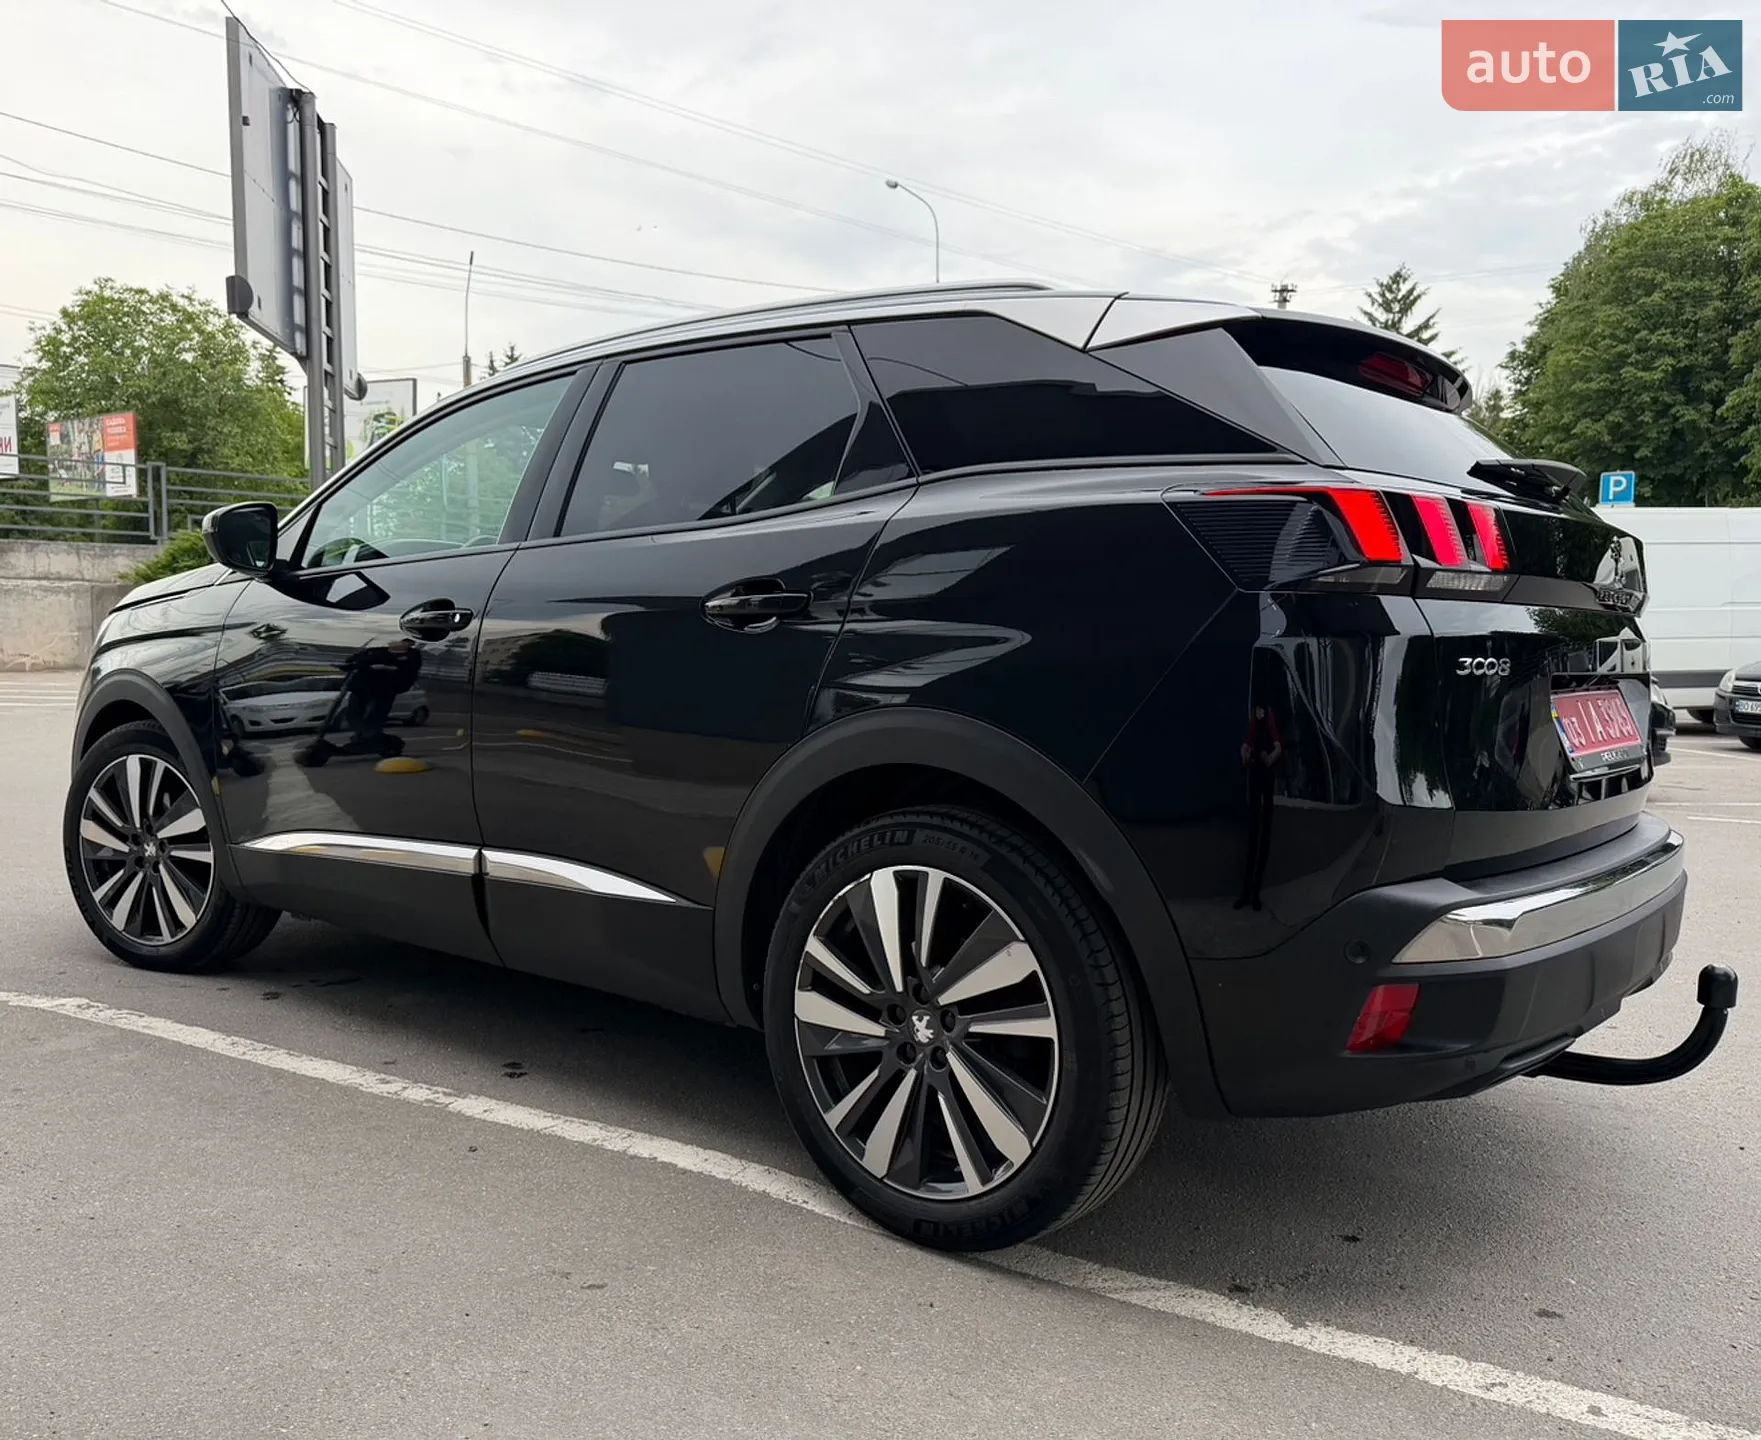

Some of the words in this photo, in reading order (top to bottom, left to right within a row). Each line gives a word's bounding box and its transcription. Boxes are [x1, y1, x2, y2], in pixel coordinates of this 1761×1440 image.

[1609, 475, 1627, 500] P
[1455, 657, 1511, 676] 3008
[814, 829, 909, 882] MICHELIN
